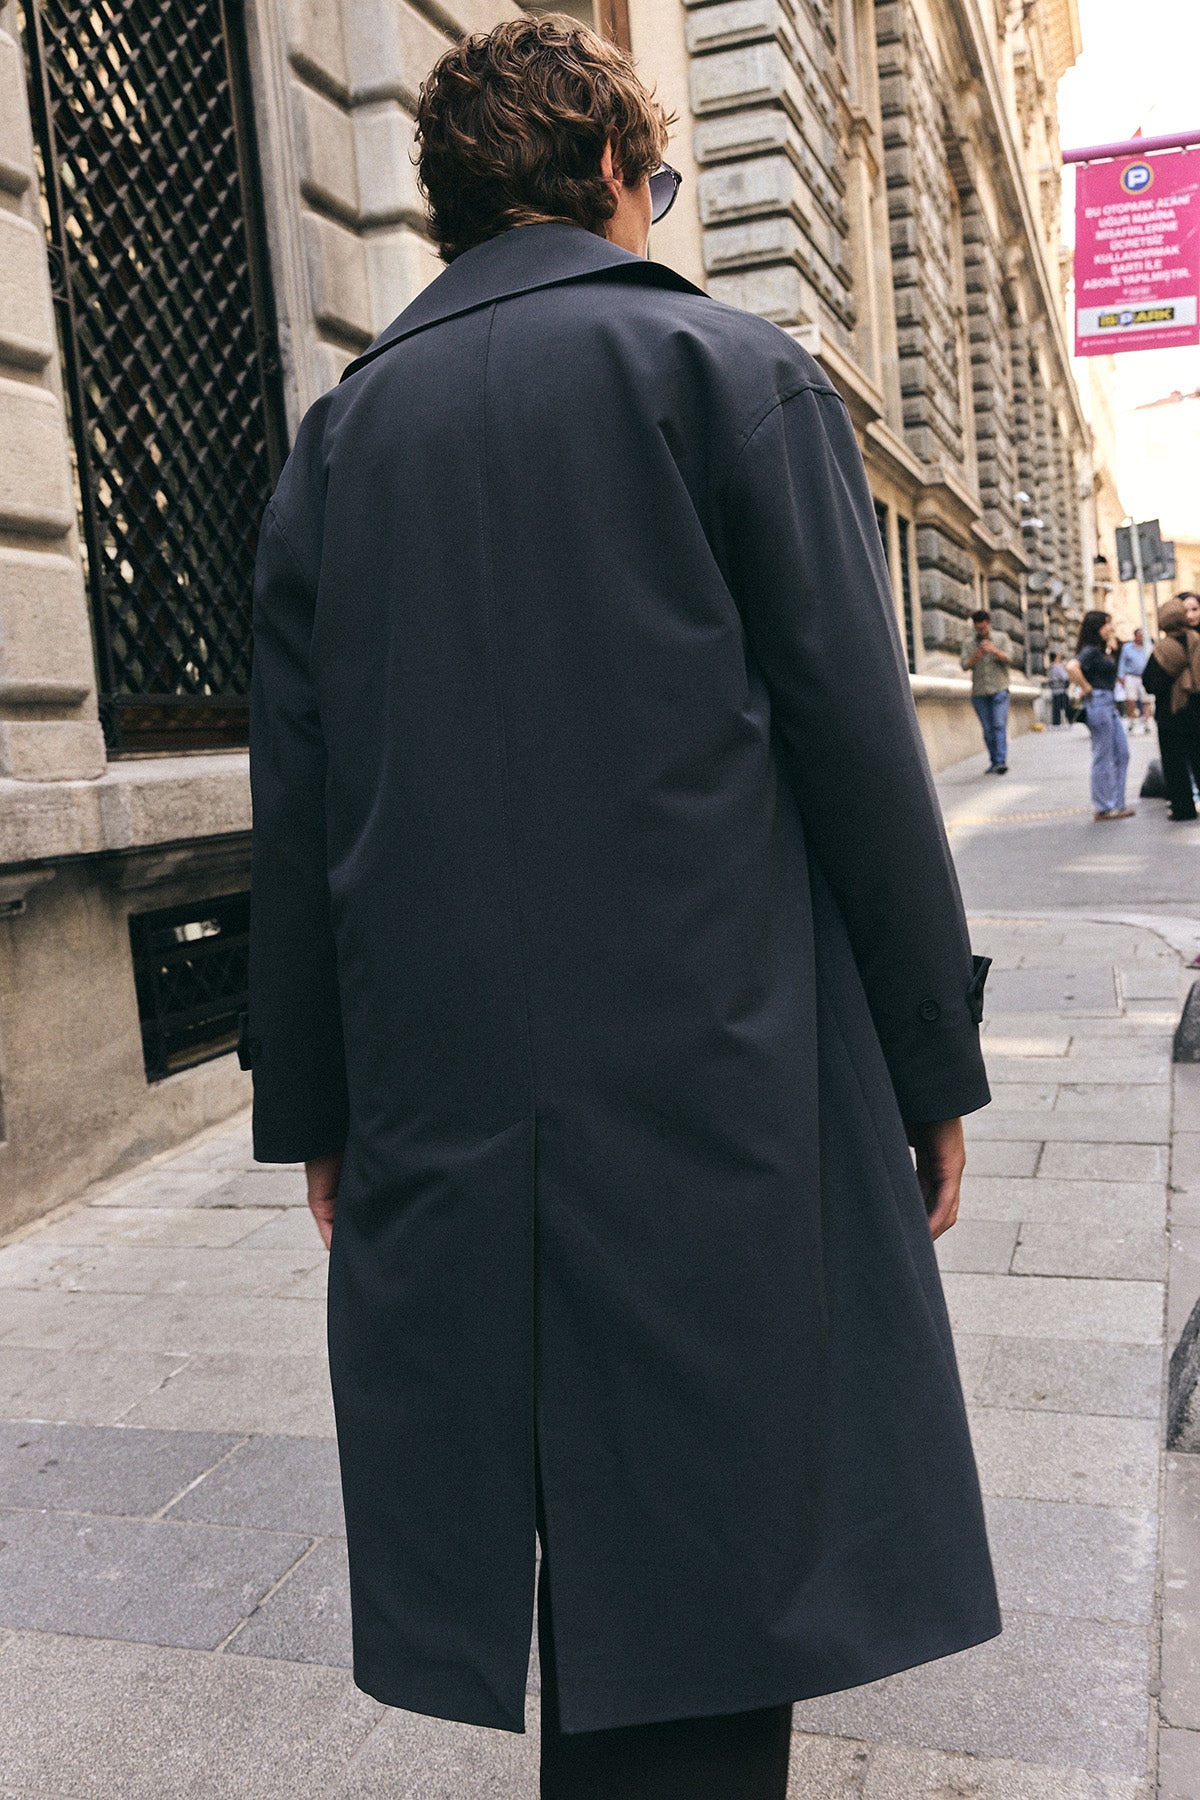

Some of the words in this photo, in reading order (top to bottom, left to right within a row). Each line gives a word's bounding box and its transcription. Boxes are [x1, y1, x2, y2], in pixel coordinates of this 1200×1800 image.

[1127, 168, 1149, 188] P
[1085, 206, 1101, 218] BU
[1102, 200, 1154, 217] OTOPARK
[1093, 244, 1180, 265] KULLANDIRMAK
[1083, 275, 1121, 290] ABONE
